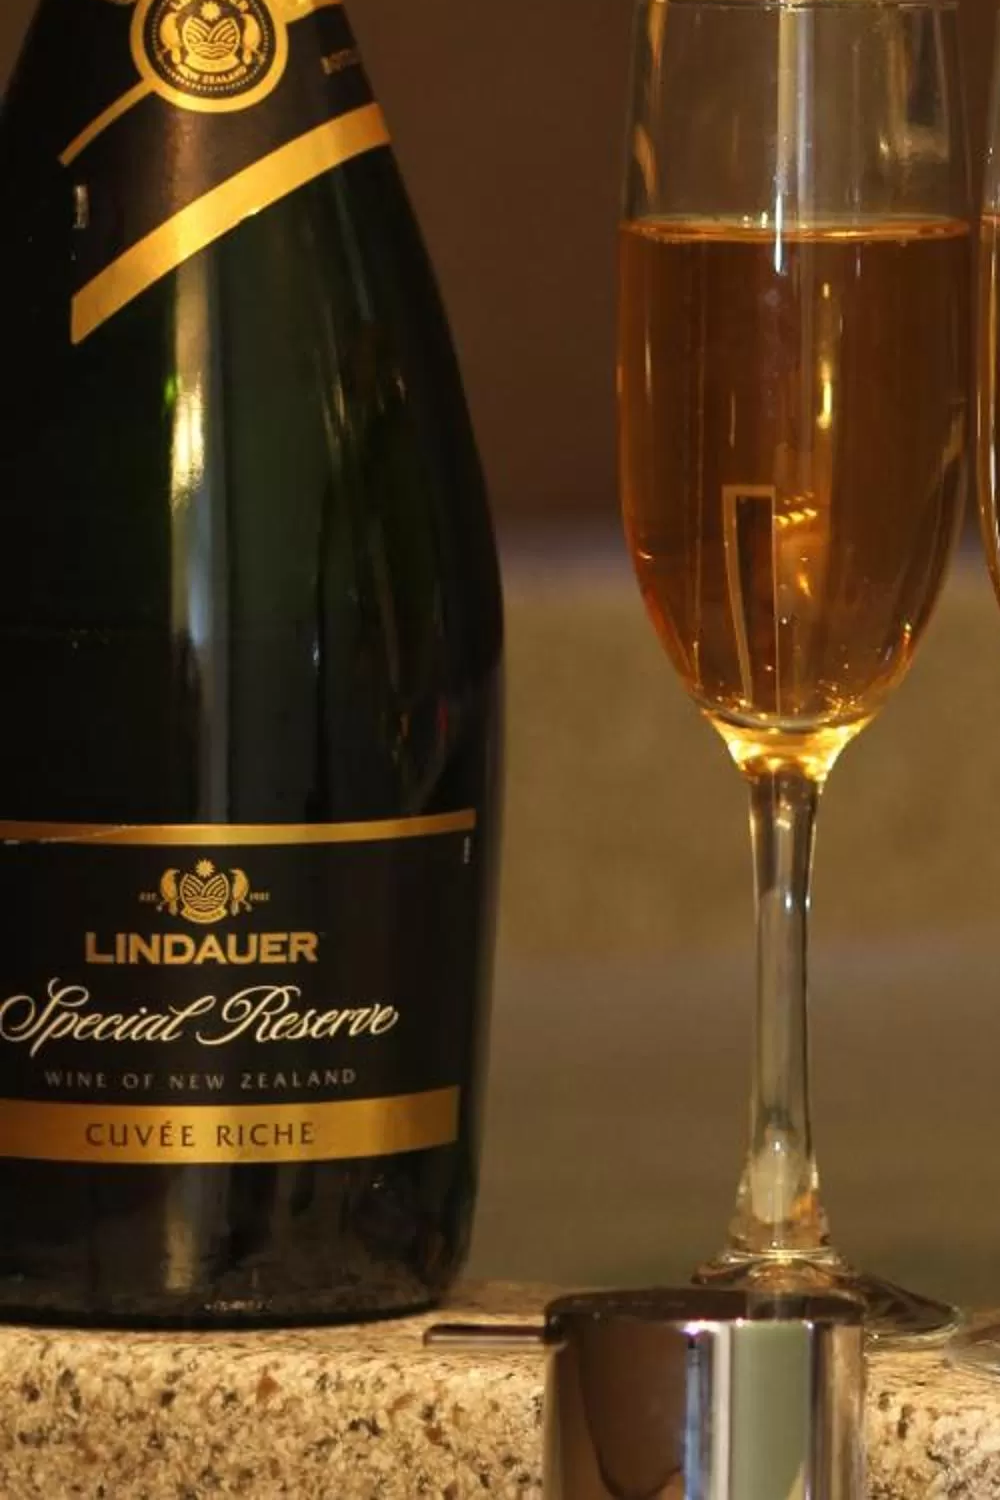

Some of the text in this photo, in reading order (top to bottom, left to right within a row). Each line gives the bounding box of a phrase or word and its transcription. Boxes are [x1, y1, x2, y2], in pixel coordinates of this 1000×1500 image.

[85, 931, 319, 965] LINDAUER
[0, 977, 399, 1058] Special Reserve
[44, 1067, 357, 1091] WINE OF NEW ZEALAND
[85, 1120, 316, 1148] CUVÉE RICHE
